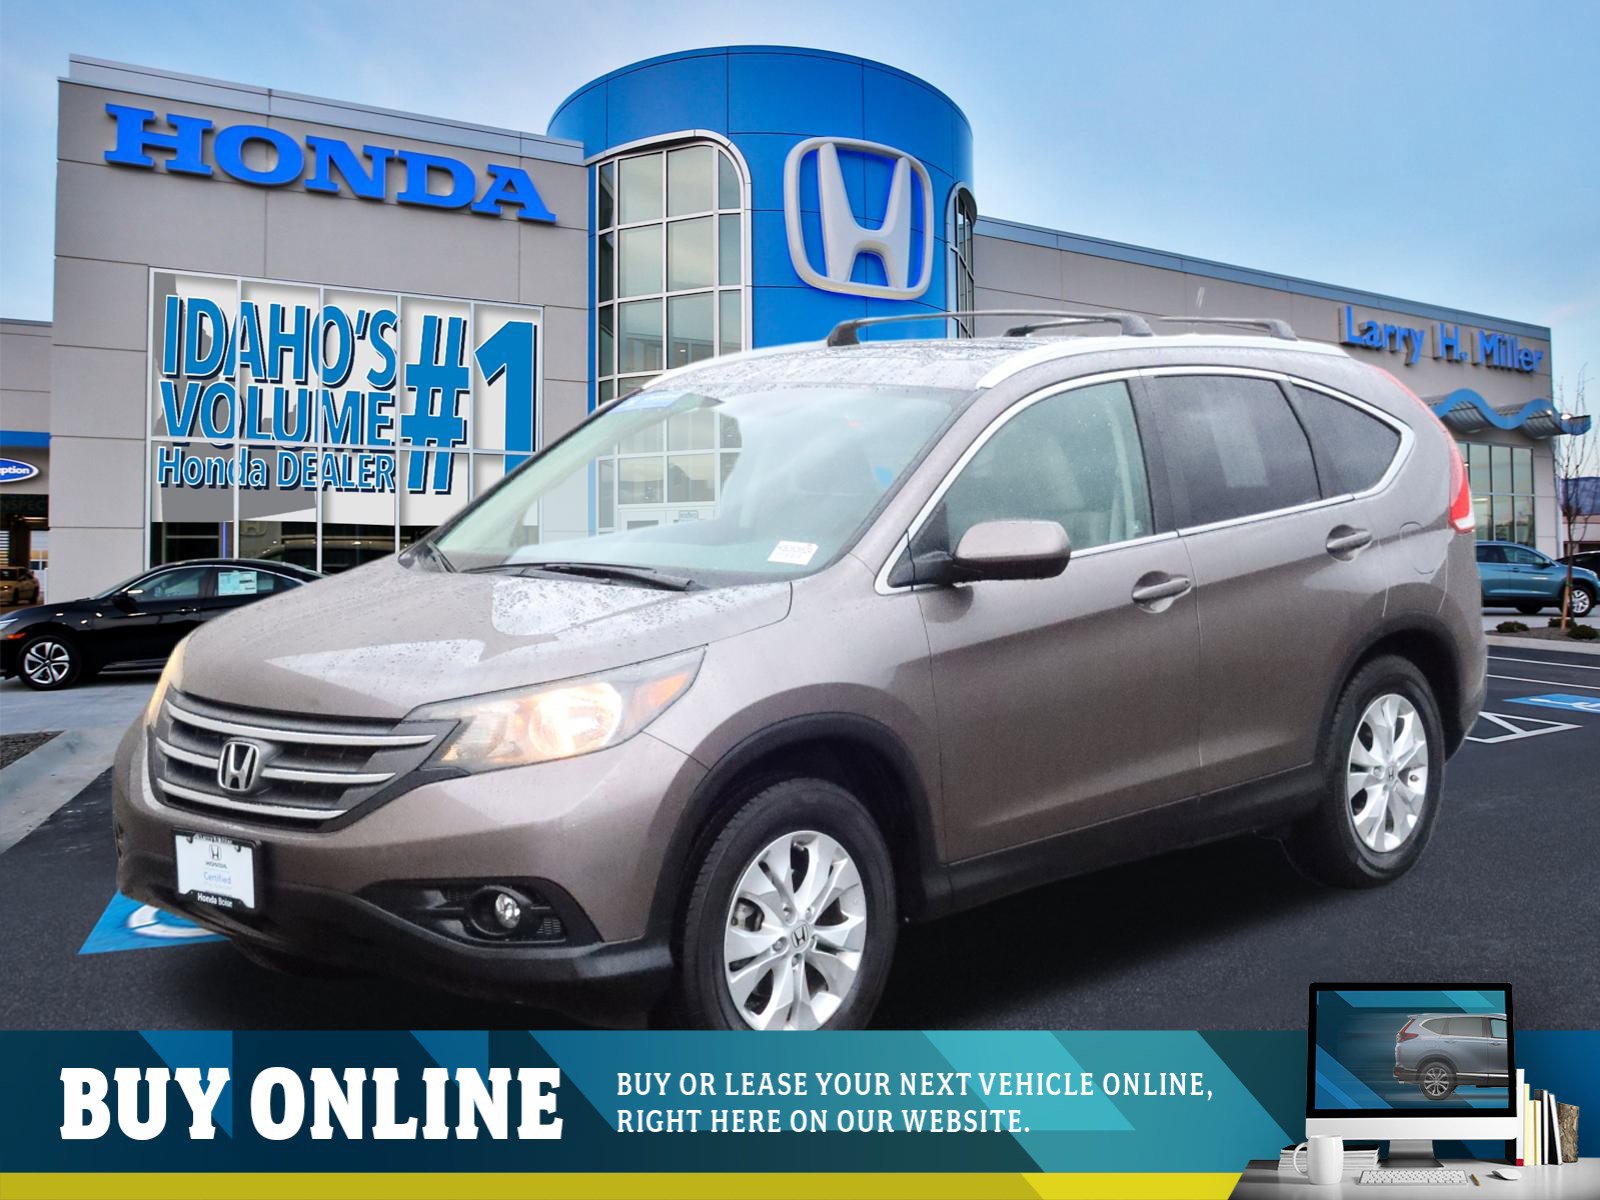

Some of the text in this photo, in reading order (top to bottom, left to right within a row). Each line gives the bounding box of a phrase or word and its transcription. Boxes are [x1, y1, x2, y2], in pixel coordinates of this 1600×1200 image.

[104, 103, 556, 224] HONDA
[162, 294, 400, 390] IDAHO'S
[1344, 306, 1544, 373] Larry H. Miller
[160, 380, 399, 449] VOLUME
[0, 465, 30, 476] ption
[157, 446, 396, 492] Honda DEALER
[198, 893, 218, 904] Honda
